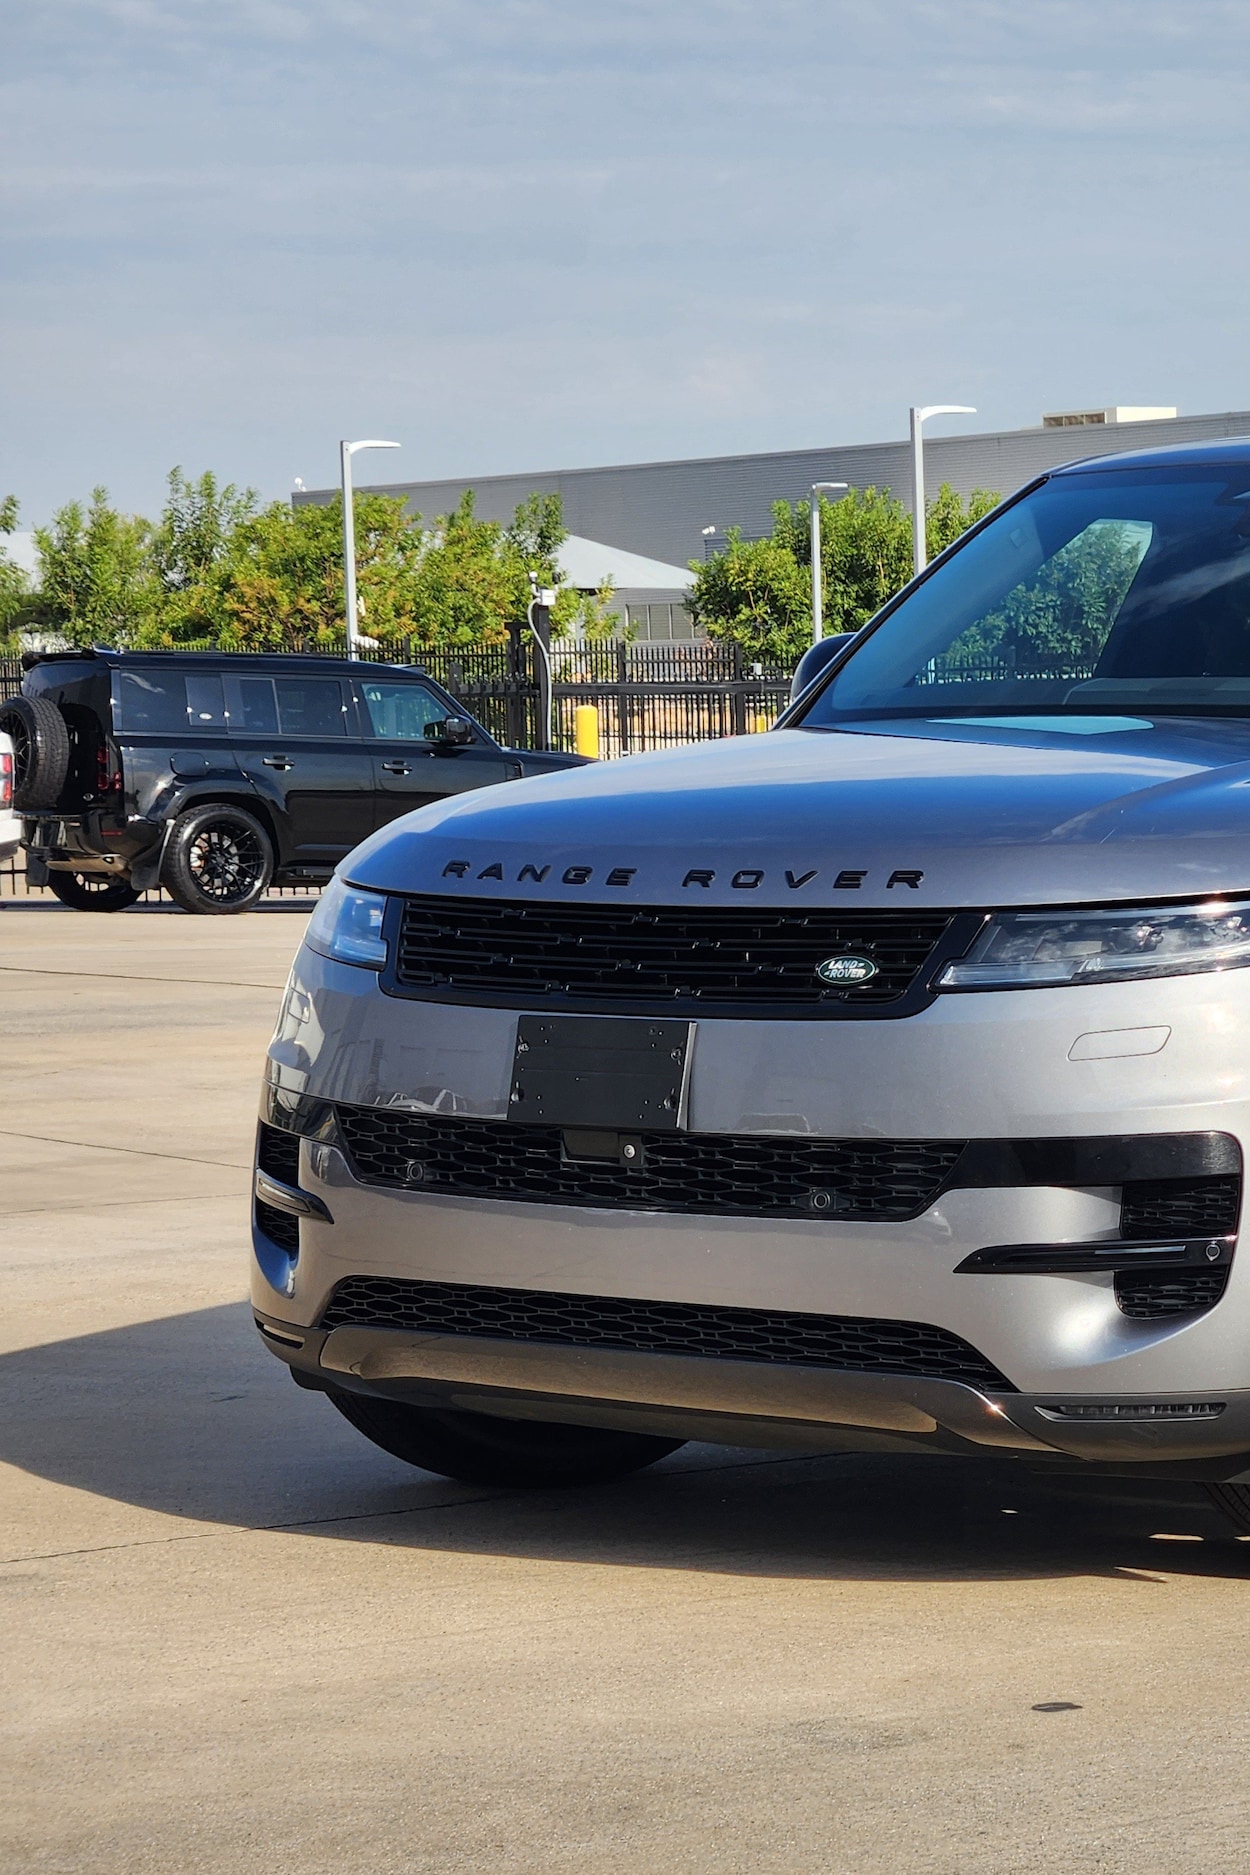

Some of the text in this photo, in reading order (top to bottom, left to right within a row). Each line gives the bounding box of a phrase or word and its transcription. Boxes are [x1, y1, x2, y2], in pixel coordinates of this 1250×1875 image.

[441, 859, 925, 889] RANGE ROVER
[828, 960, 858, 969] LAND
[829, 968, 867, 978] ROVER
